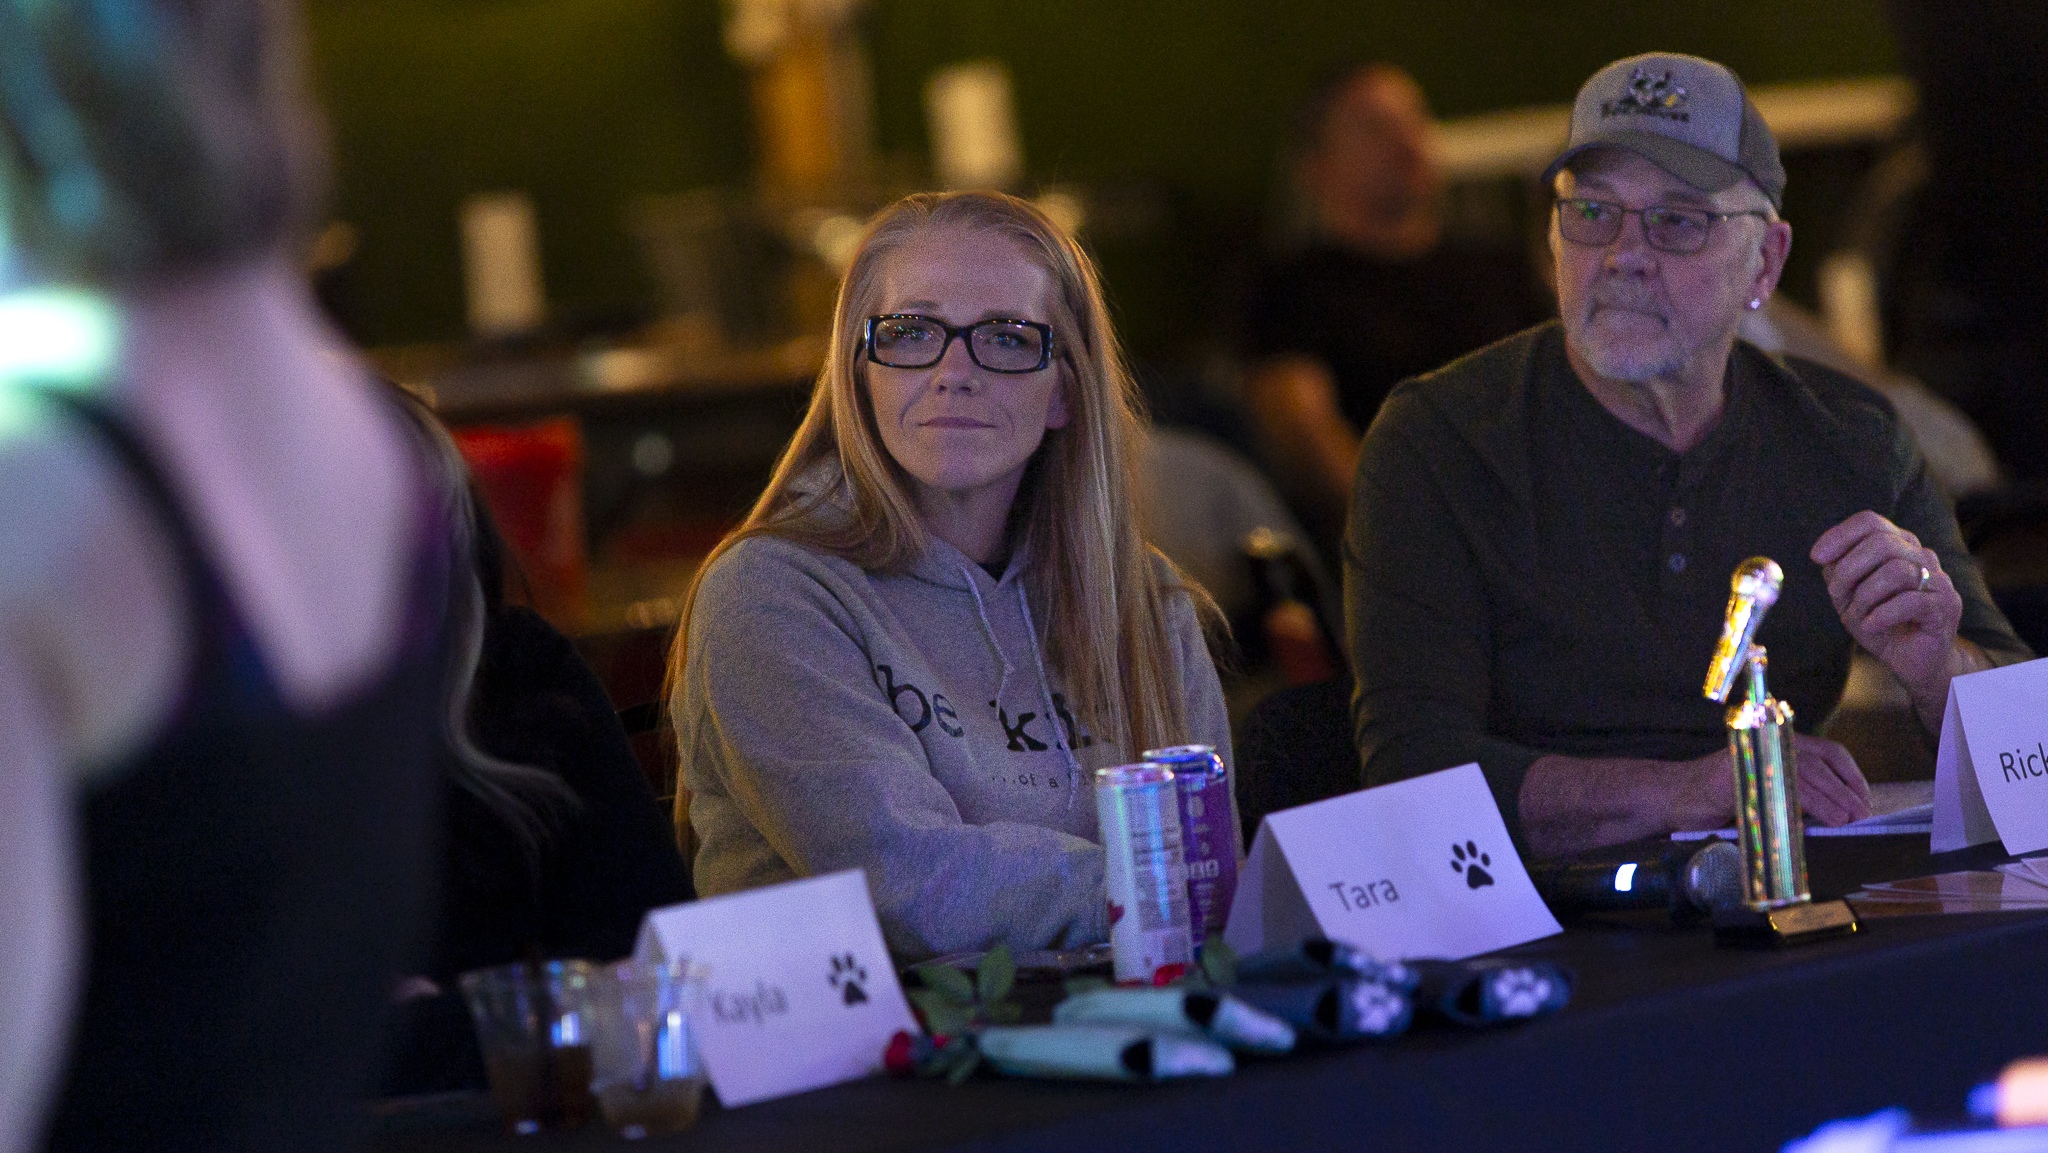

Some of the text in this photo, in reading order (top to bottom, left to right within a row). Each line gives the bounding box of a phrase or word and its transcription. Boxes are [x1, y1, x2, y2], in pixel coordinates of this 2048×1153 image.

[877, 664, 1091, 753] be ki
[1048, 776, 1060, 789] a
[1328, 877, 1400, 912] Tara
[710, 980, 789, 1024] Kayla
